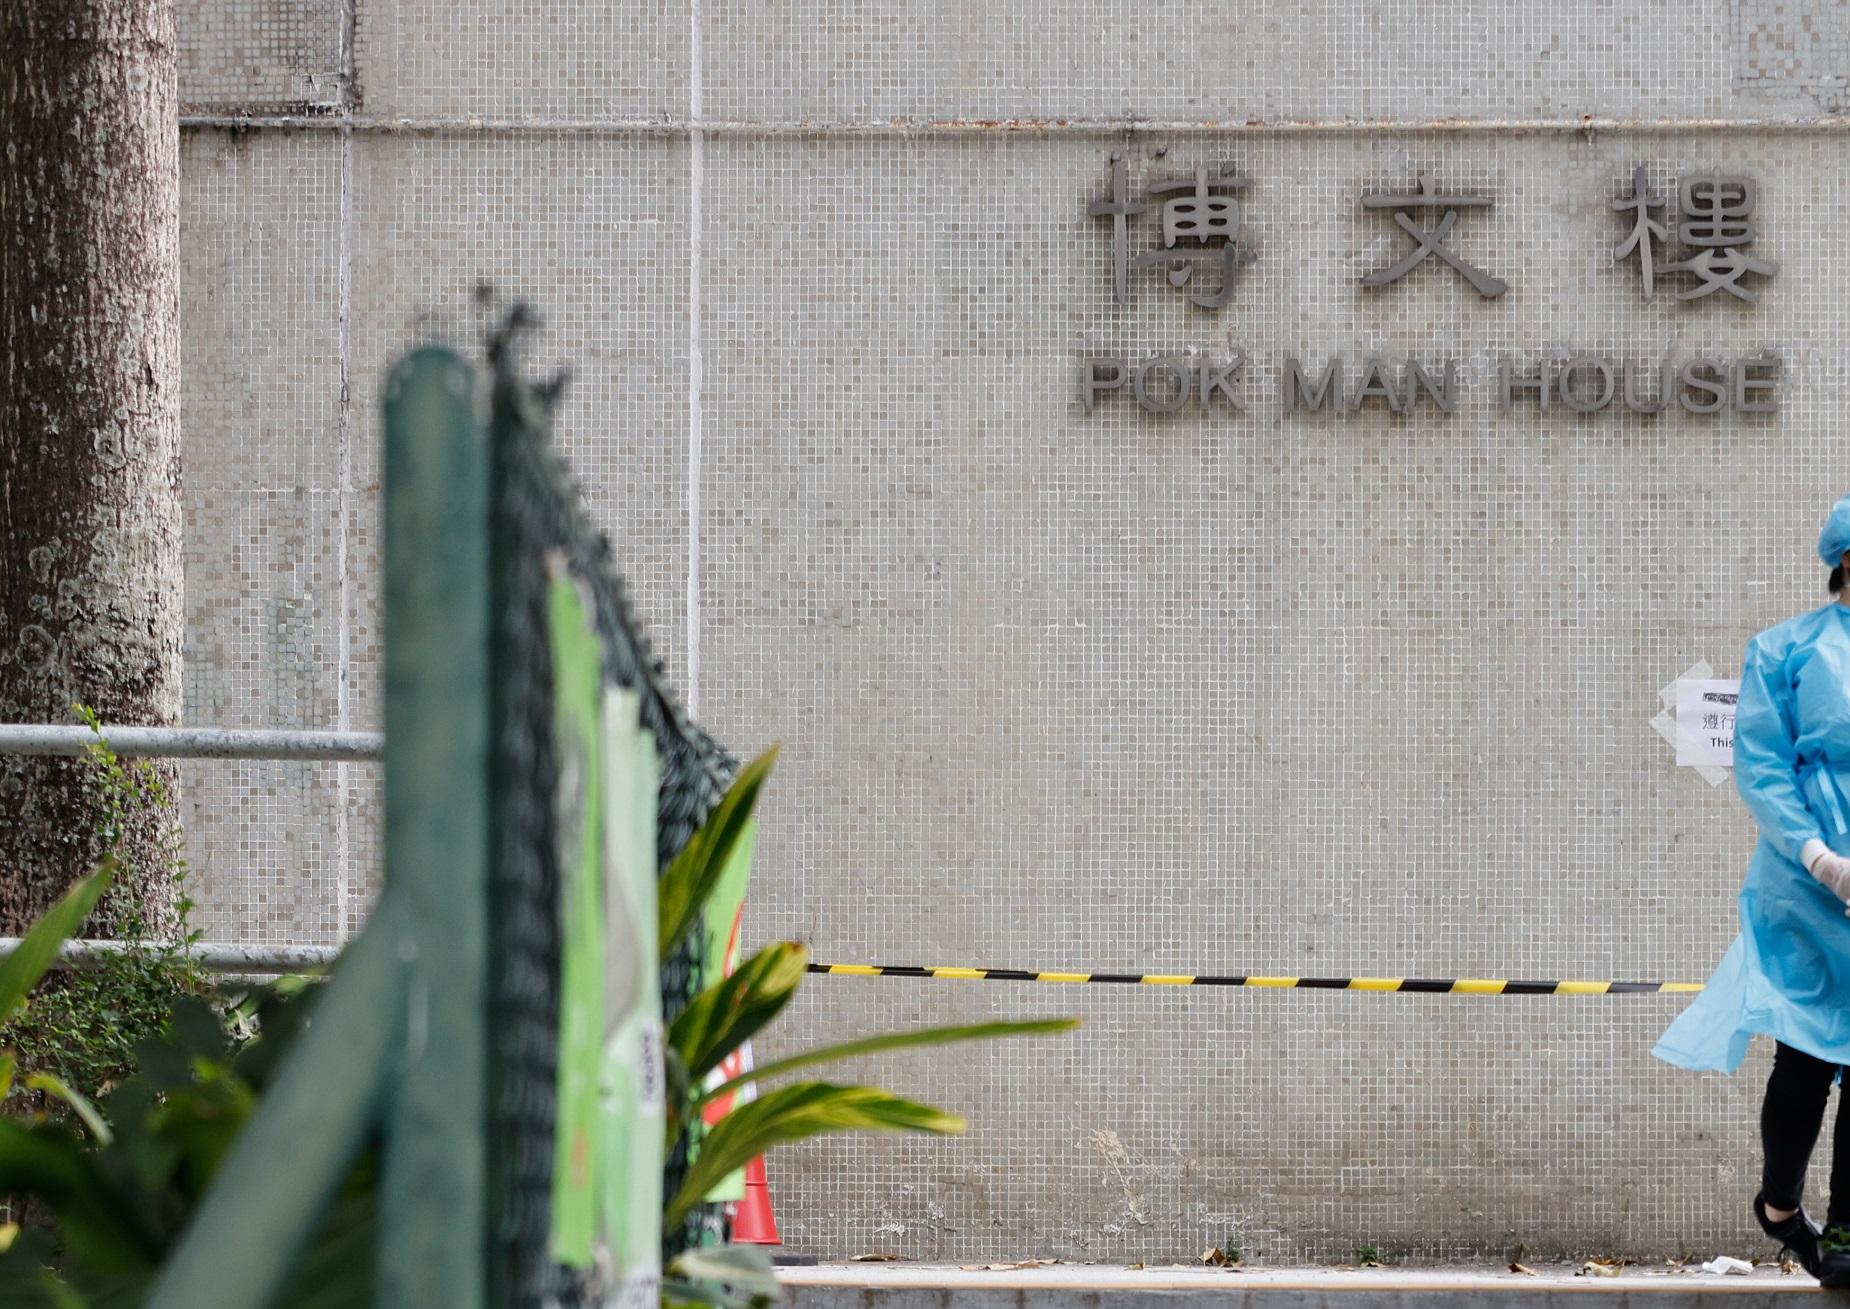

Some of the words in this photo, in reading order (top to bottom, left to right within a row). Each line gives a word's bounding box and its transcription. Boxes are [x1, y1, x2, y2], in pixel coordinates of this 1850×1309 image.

[1087, 158, 1781, 308] 博文樓
[1084, 355, 1242, 414] POK
[1285, 355, 1456, 414] MAN
[1504, 355, 1783, 414] HOUSE
